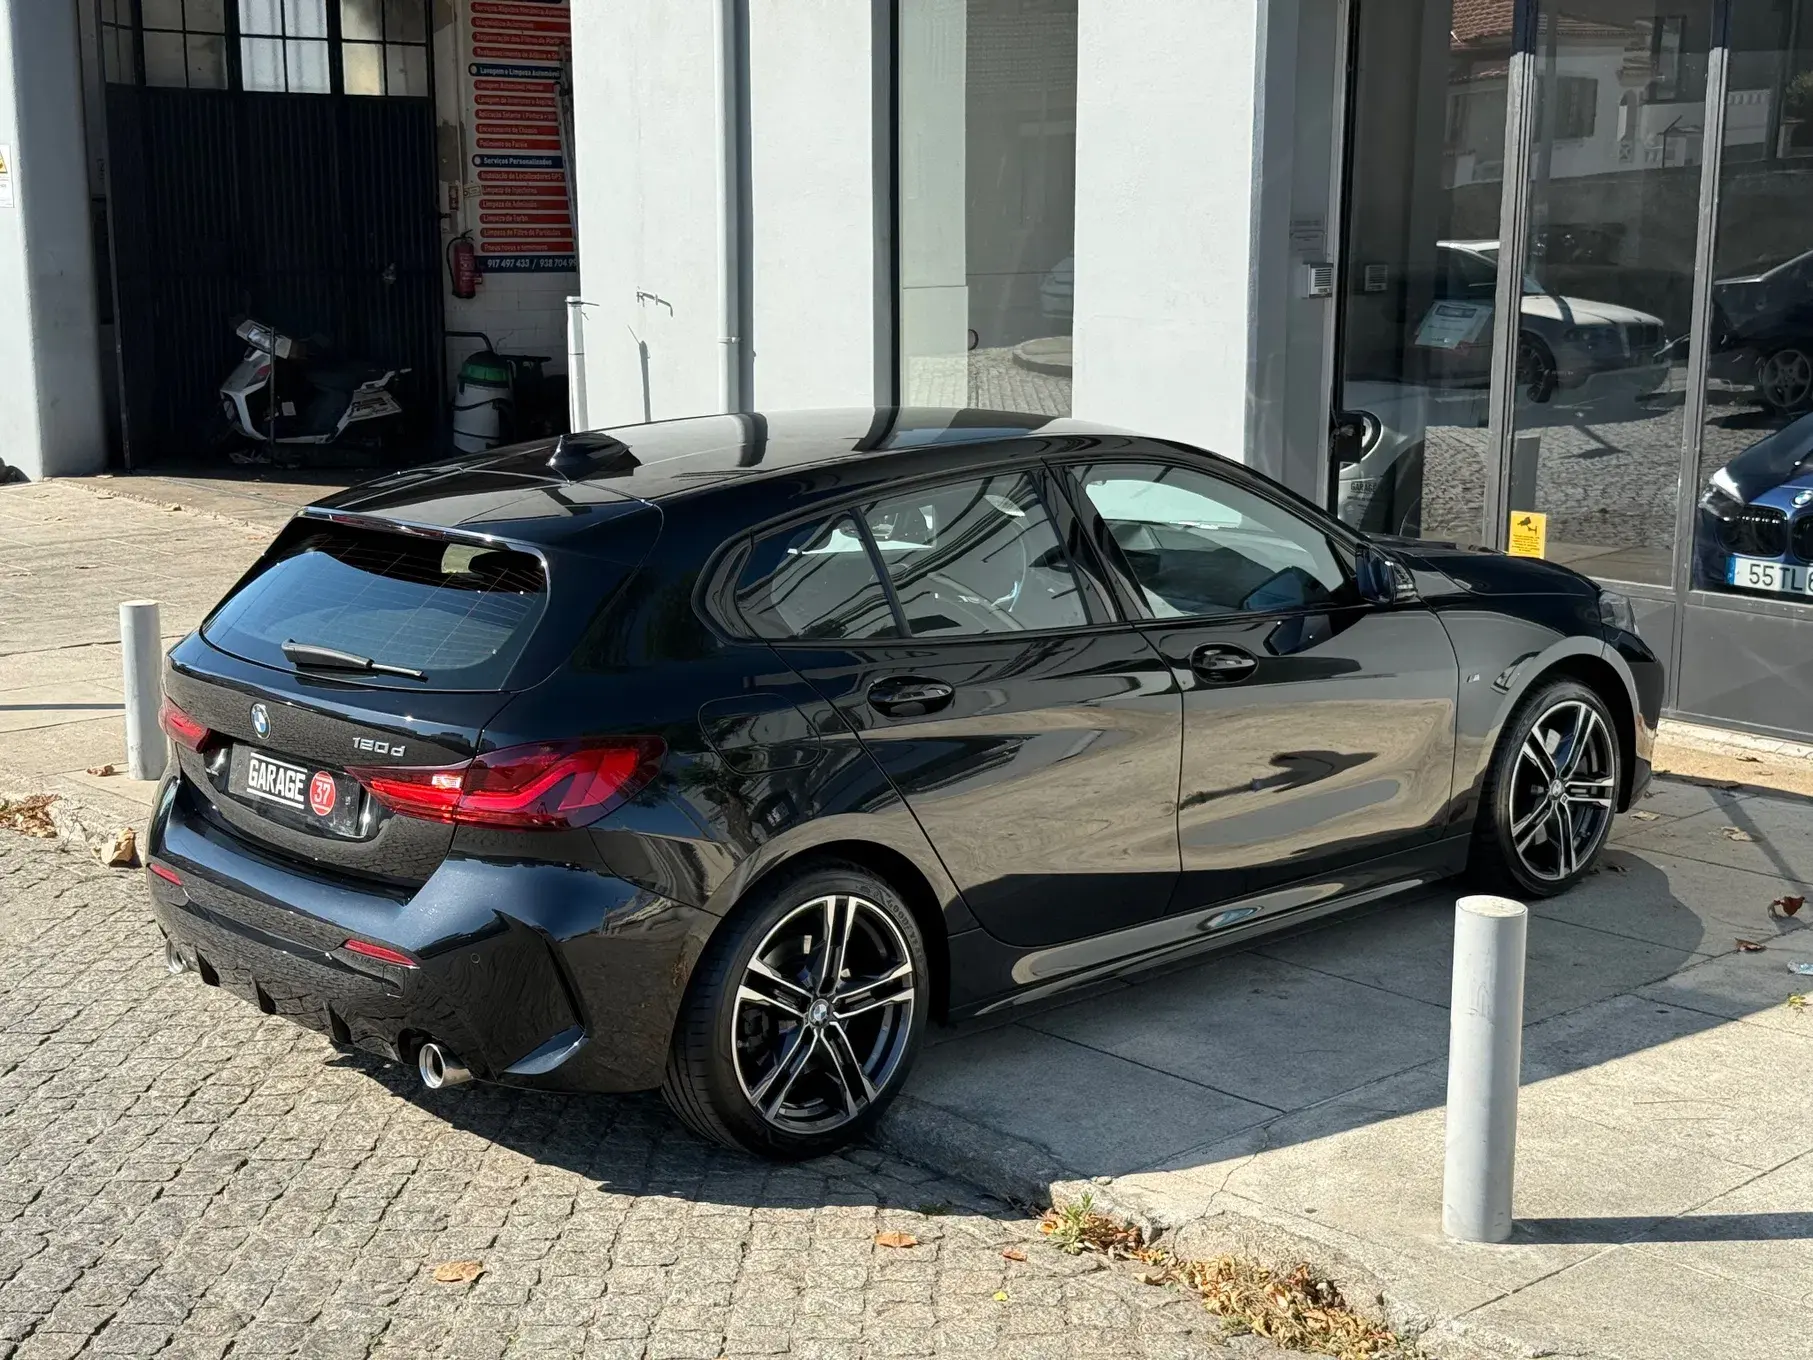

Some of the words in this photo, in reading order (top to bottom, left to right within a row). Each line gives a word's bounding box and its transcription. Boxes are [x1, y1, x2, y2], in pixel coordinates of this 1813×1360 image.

[480, 67, 504, 76] Lavagem
[509, 68, 531, 77] Limpeza
[484, 157, 508, 166] Serviços
[488, 259, 499, 268] 917
[500, 259, 514, 268] 497
[516, 259, 529, 267] 433
[540, 259, 552, 268] 938
[554, 259, 567, 267] 704
[1749, 563, 1774, 587] 55
[1778, 567, 1803, 591] TL
[352, 736, 406, 758] 120d
[248, 758, 306, 802] GARAGE
[314, 780, 330, 804] 37
